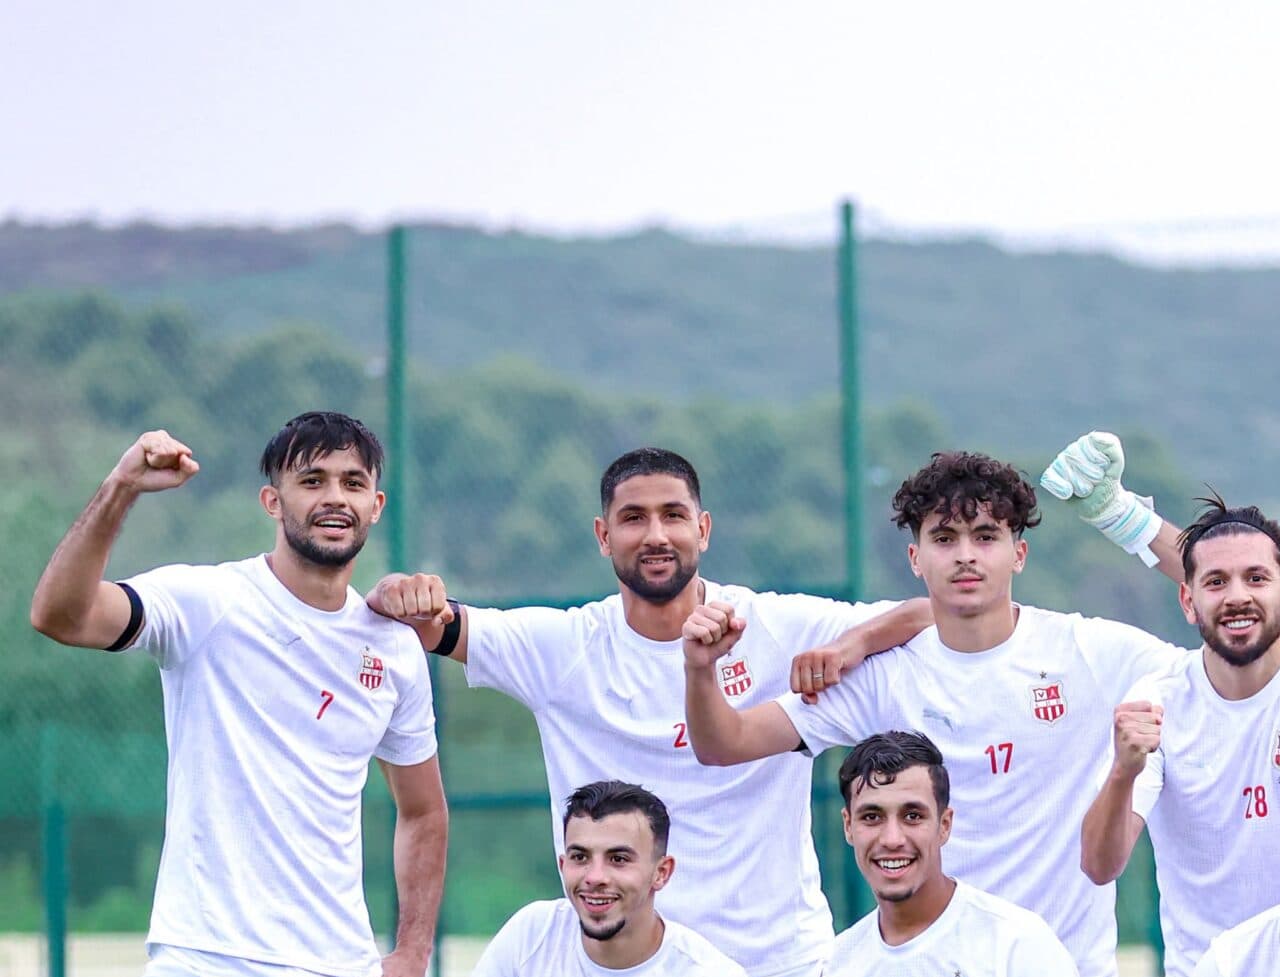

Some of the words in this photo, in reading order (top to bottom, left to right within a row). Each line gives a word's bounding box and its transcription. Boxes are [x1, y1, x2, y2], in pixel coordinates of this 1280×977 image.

[316, 689, 335, 720] 7
[985, 742, 1014, 774] 17
[1242, 785, 1268, 819] 28
